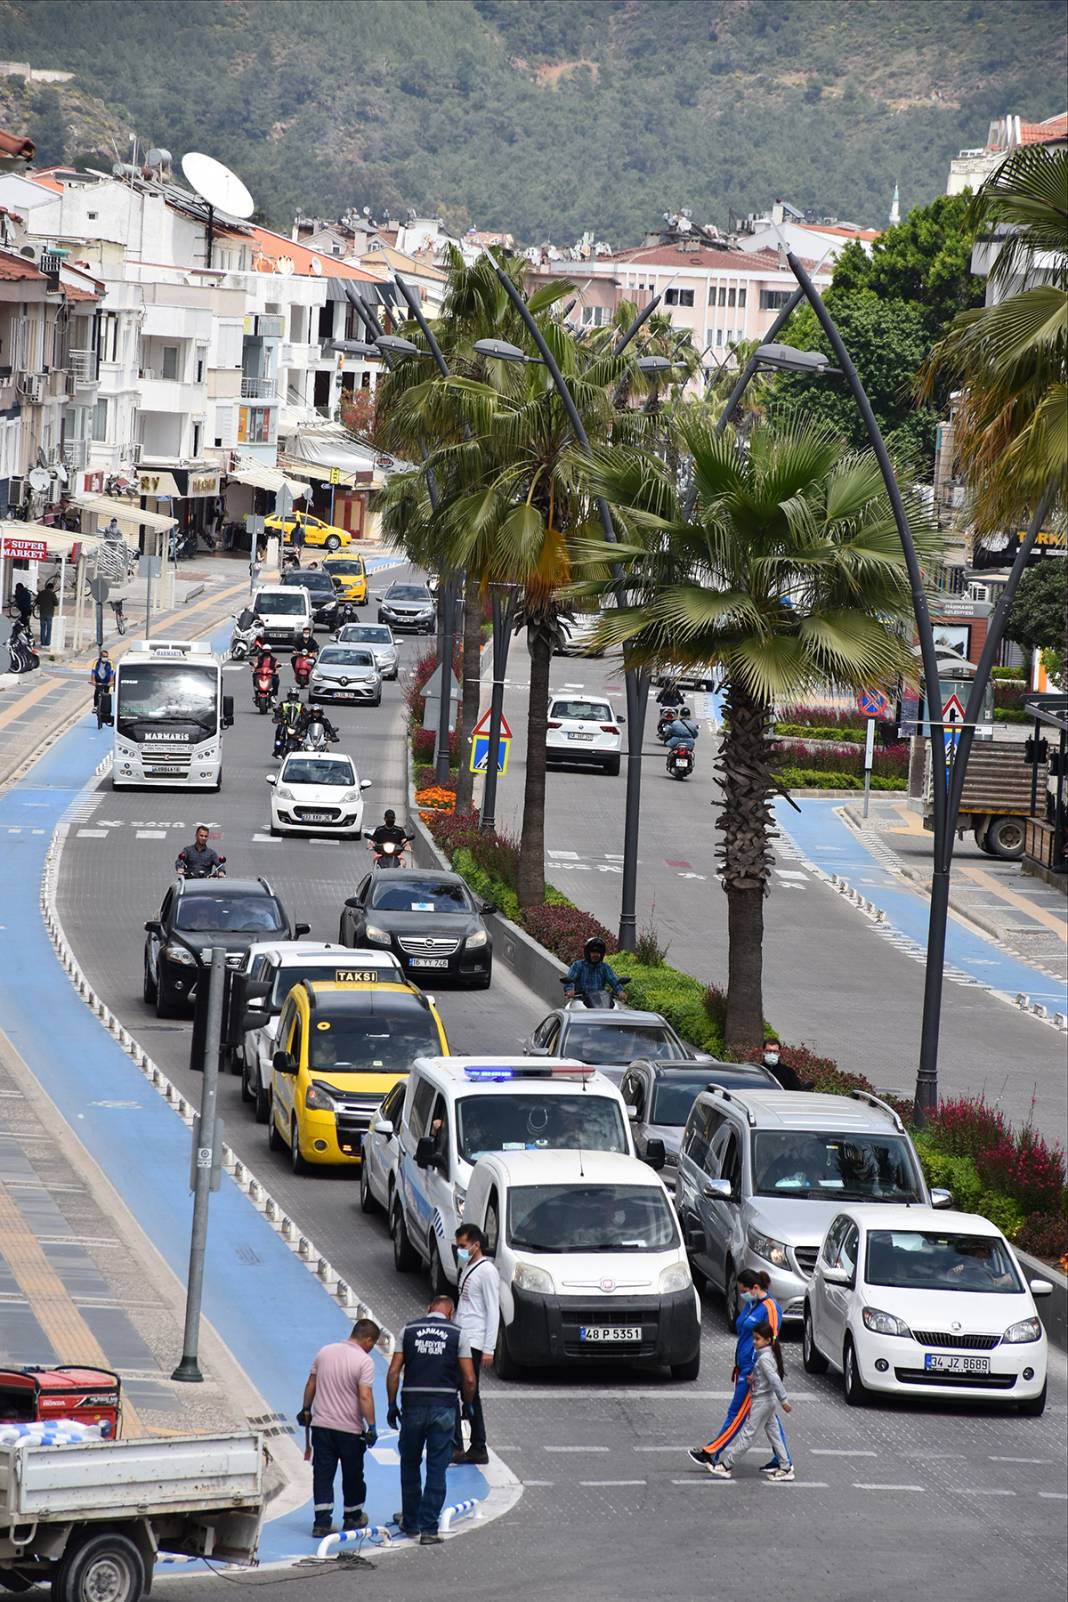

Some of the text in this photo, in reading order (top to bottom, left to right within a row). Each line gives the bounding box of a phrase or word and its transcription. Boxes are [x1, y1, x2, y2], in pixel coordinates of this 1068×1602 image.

[11, 540, 45, 550] SUPER
[2, 548, 45, 559] MARKET
[338, 971, 376, 981] TAKSI
[586, 1327, 640, 1339] 48 P 5351
[931, 1356, 988, 1370] 34 JZ 8689
